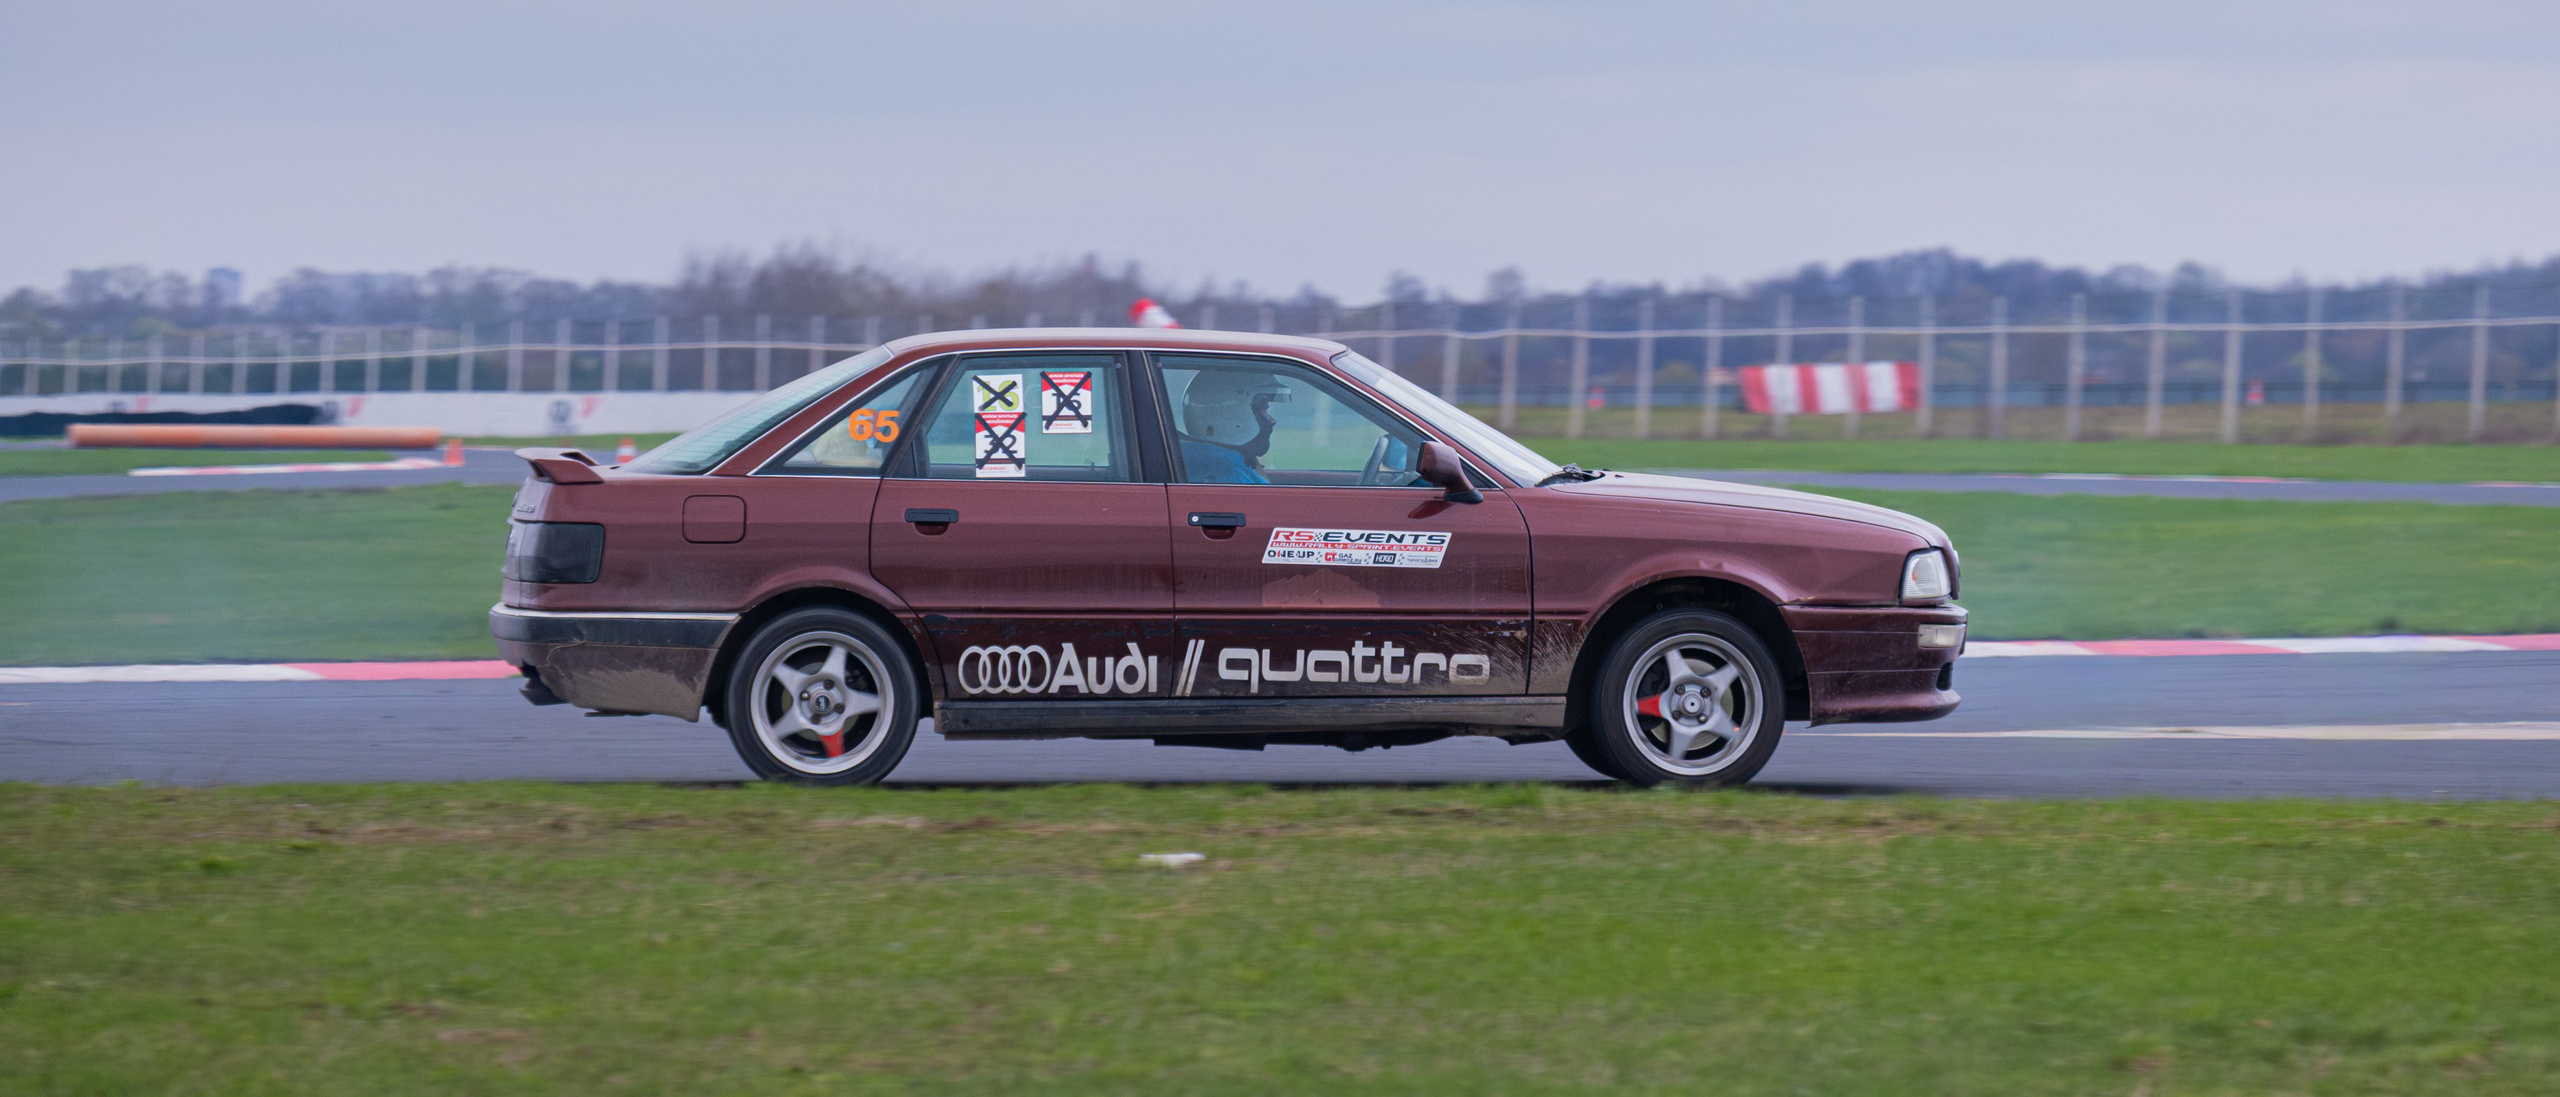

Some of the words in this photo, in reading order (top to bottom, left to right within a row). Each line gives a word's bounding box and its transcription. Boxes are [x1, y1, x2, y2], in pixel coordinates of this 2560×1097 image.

[977, 380, 1019, 411] 16
[848, 408, 899, 443] 65
[1273, 530, 1314, 541] RS
[1323, 531, 1448, 545] EVENTS
[1047, 642, 1158, 694] Audi
[1217, 640, 1490, 694] quattro
